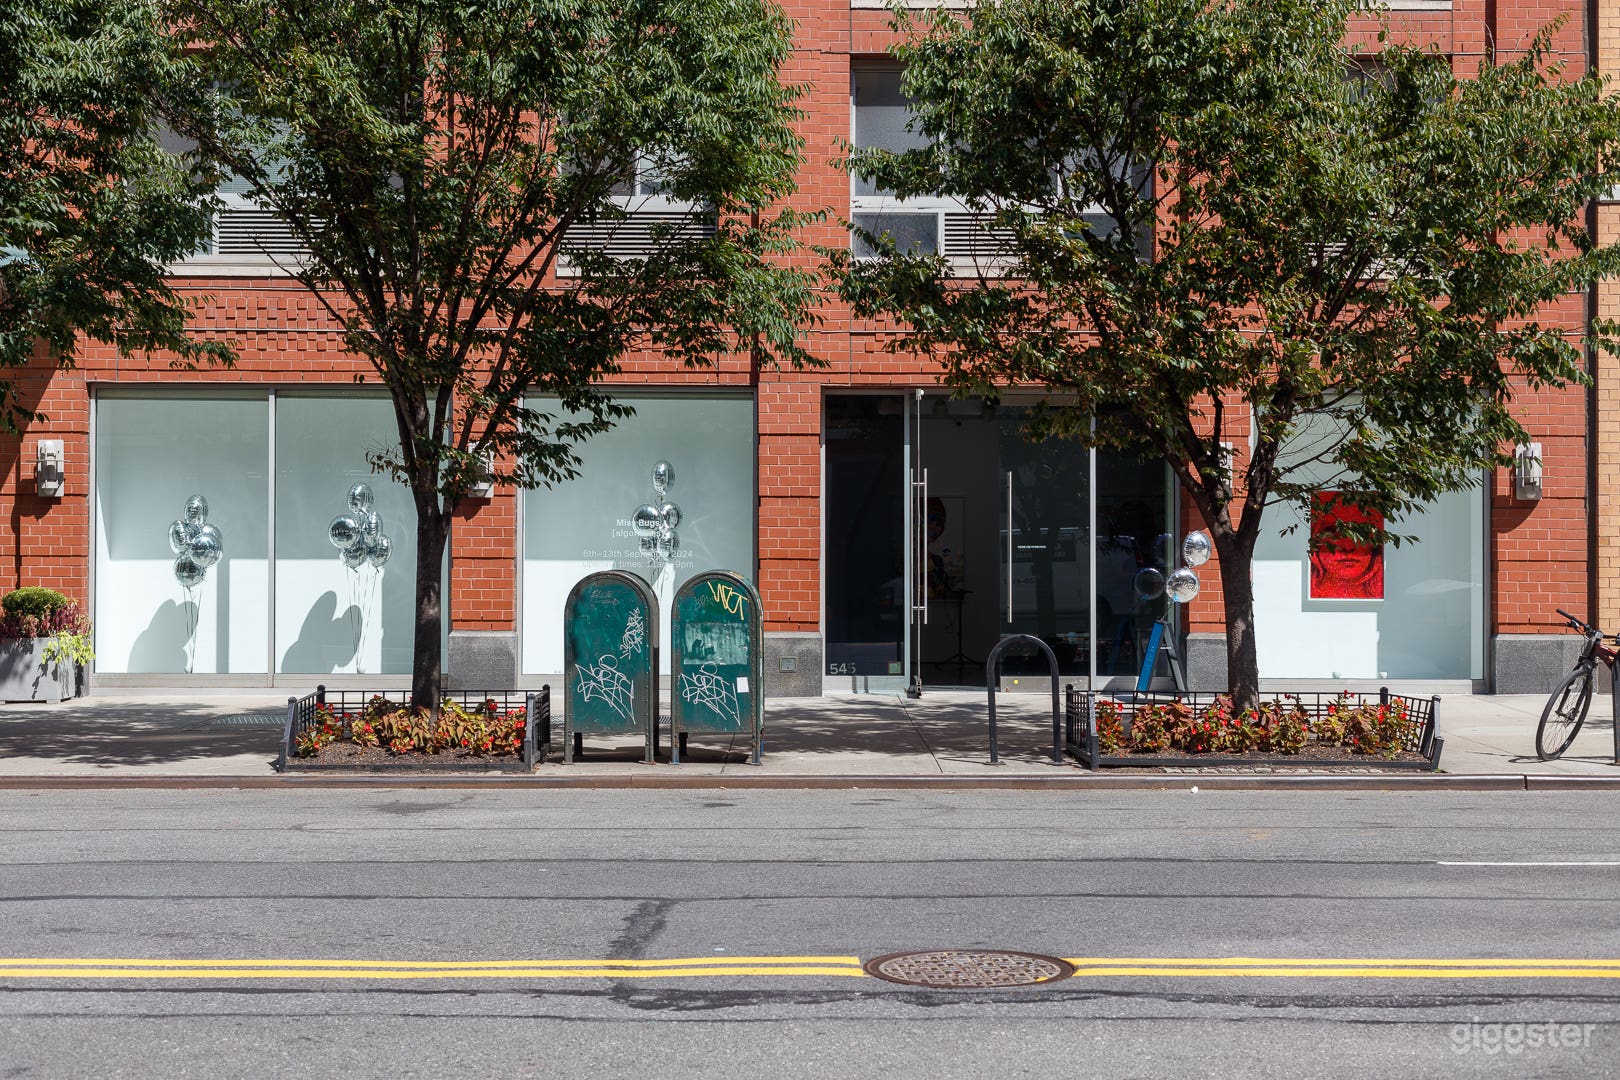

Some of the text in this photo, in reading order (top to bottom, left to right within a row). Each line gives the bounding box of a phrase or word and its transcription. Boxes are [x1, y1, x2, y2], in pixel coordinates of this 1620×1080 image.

[638, 518, 660, 529] Bugs
[624, 549, 669, 559] Septe
[671, 549, 693, 558] 2024
[829, 662, 856, 675] 545
